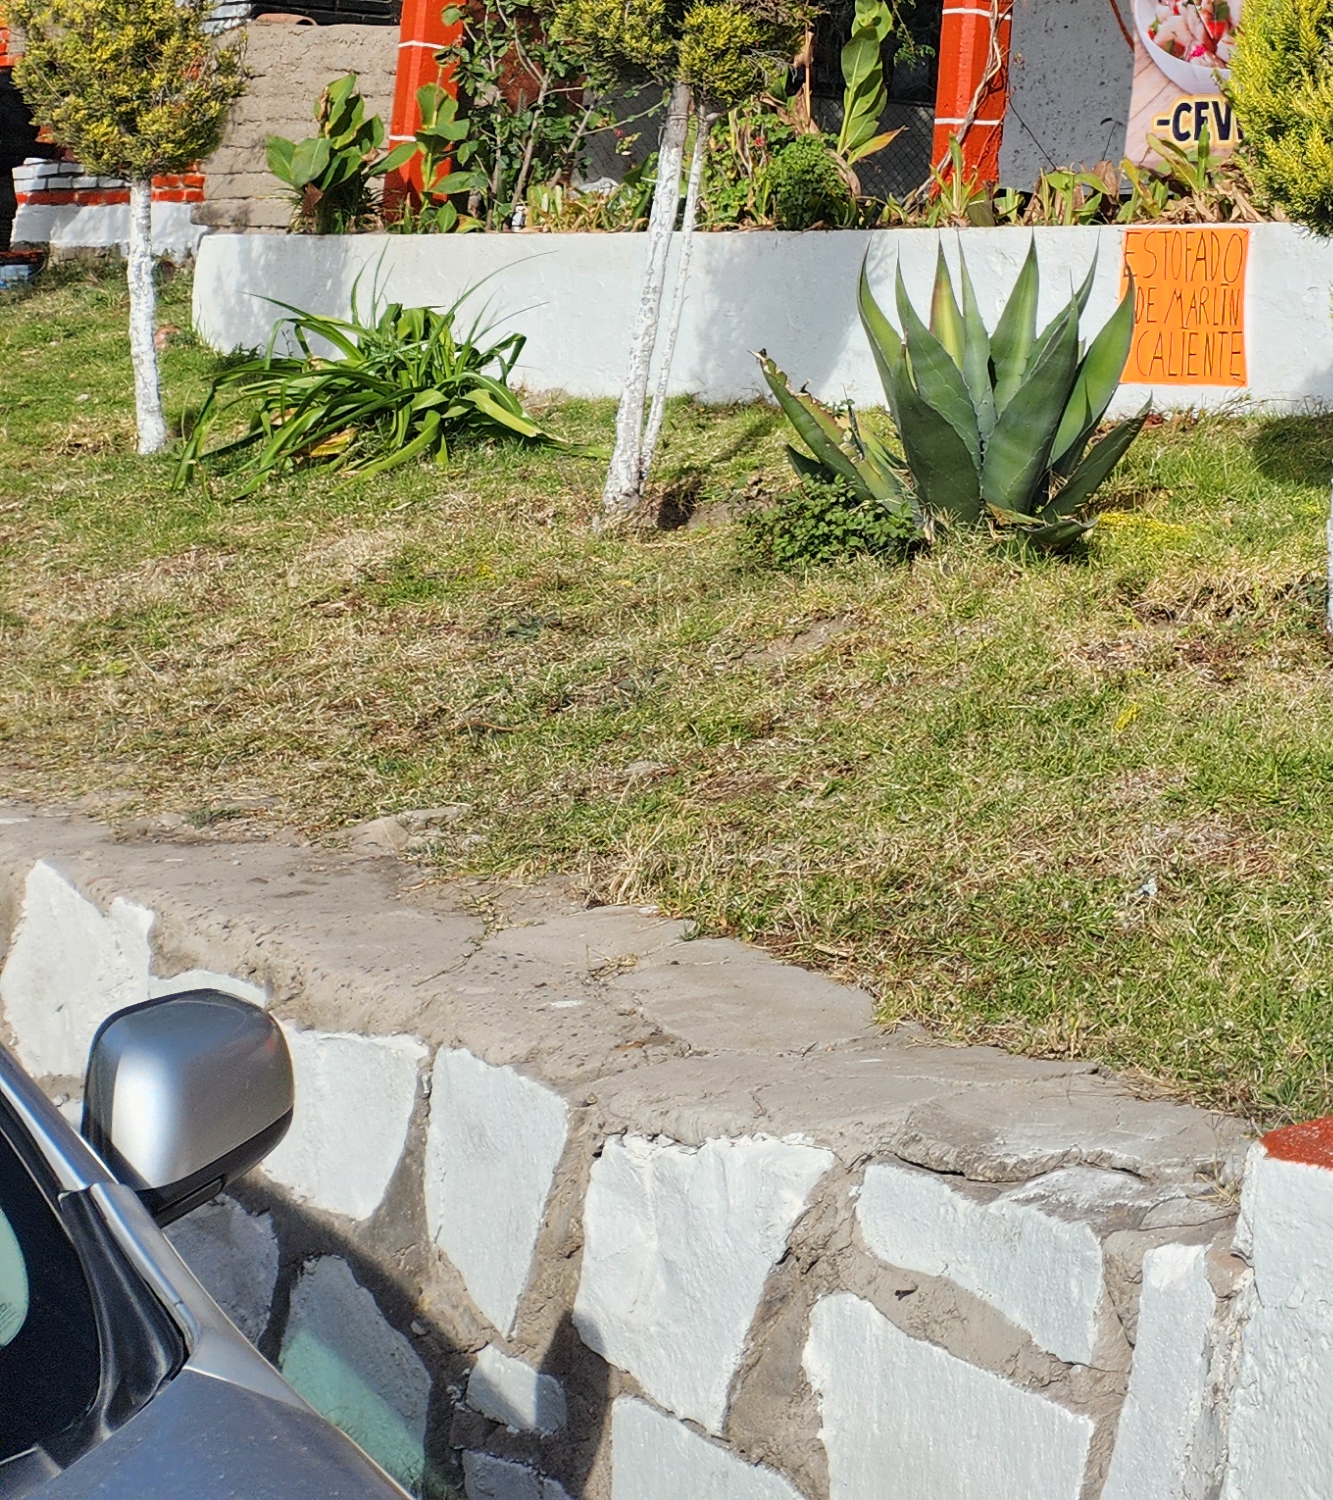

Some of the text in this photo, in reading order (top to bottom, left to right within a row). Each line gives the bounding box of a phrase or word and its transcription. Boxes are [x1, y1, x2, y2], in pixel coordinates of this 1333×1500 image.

[1123, 230, 1243, 283] ESTOFADO
[1135, 286, 1157, 325] DE
[1136, 330, 1243, 377] CALIENTE
